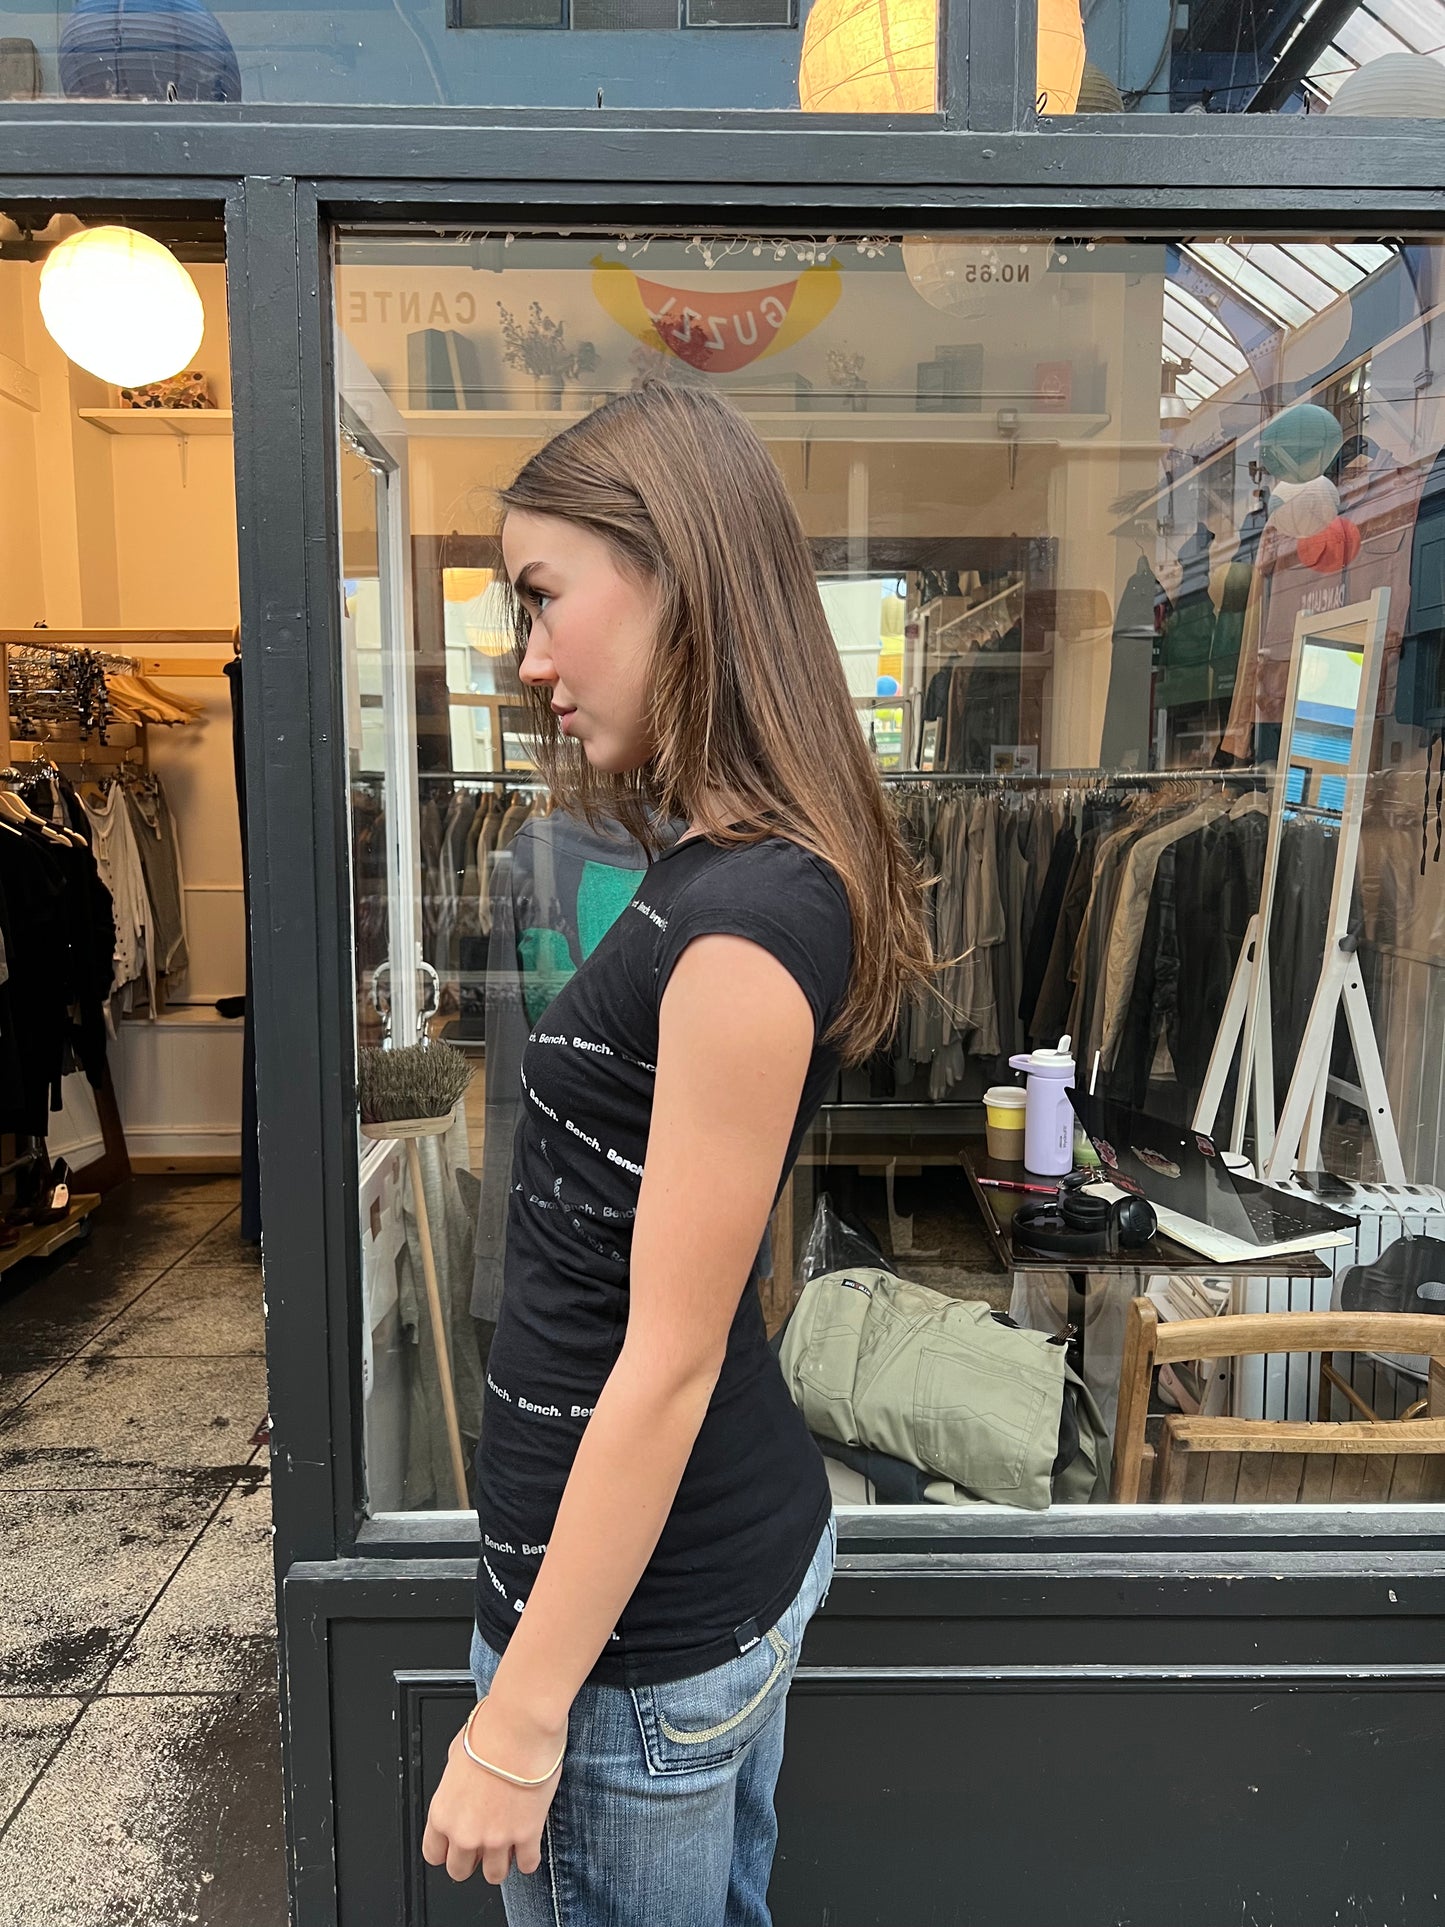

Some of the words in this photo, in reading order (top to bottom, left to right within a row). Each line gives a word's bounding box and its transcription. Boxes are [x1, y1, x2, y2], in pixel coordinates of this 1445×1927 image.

[538, 1033, 568, 1046] Bench.
[572, 1037, 614, 1056] Bench.
[529, 1087, 559, 1122] Bench.
[565, 1119, 602, 1152] Bench.
[518, 1397, 562, 1417] Bench.
[484, 1533, 516, 1554] Bench.
